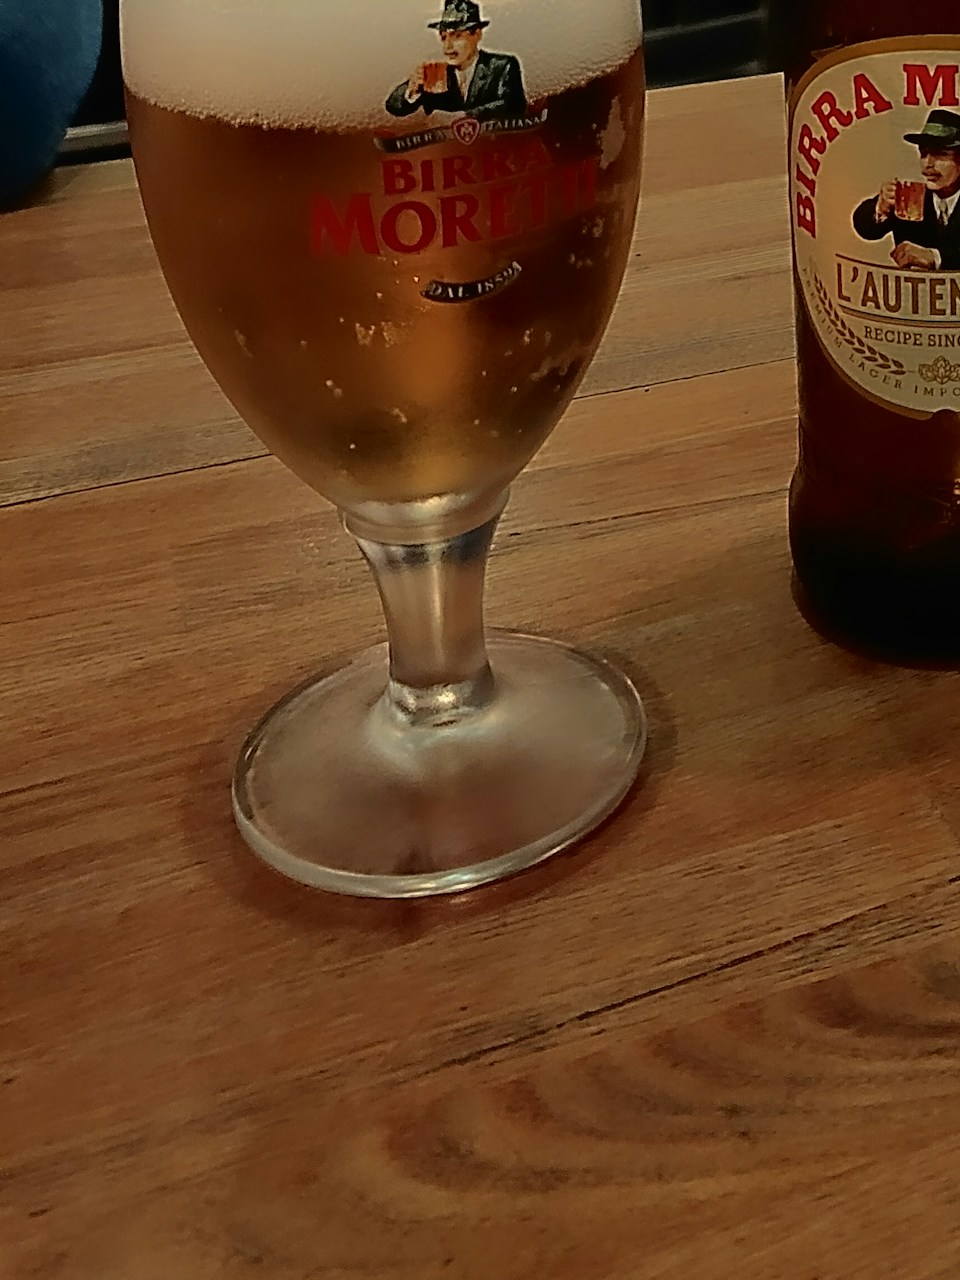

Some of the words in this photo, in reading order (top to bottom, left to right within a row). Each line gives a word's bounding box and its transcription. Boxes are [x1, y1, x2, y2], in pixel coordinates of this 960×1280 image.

[381, 136, 554, 196] BIRRA
[795, 72, 893, 239] BIRRA
[310, 158, 599, 259] MORETTI
[863, 325, 923, 347] RECIPE
[848, 353, 903, 390] LAGER
